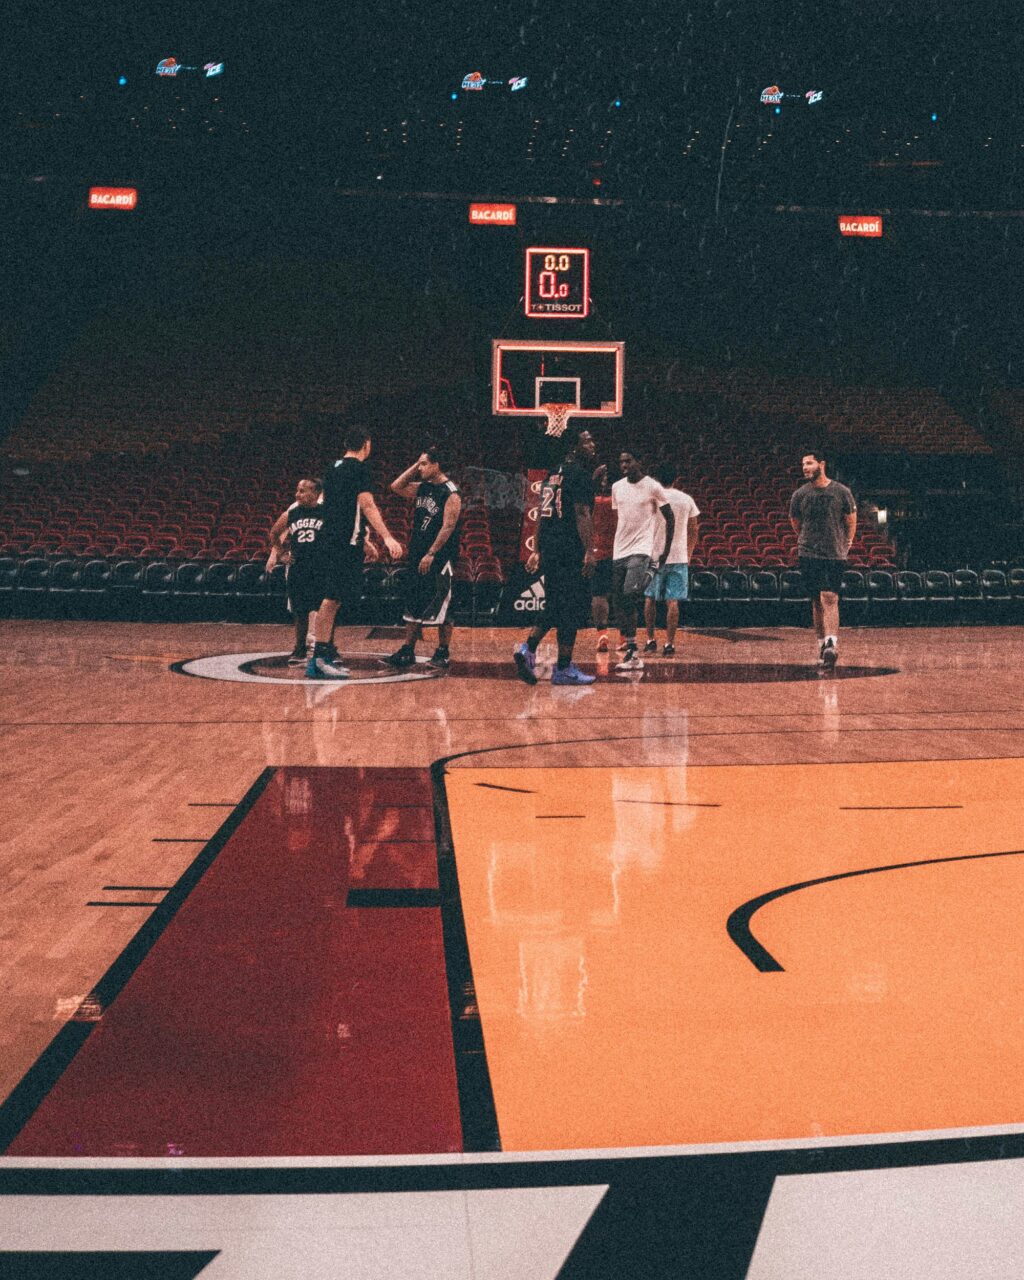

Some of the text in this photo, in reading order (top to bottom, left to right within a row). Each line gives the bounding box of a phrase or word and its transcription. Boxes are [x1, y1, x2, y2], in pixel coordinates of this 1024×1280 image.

[90, 192, 134, 205] BACARDÍ
[471, 207, 514, 220] BACARDÍ
[839, 220, 880, 233] BACARDÍ
[544, 254, 569, 271] 0.0
[545, 303, 583, 312] TISSOT
[421, 516, 432, 531] 7
[297, 530, 315, 543] 23
